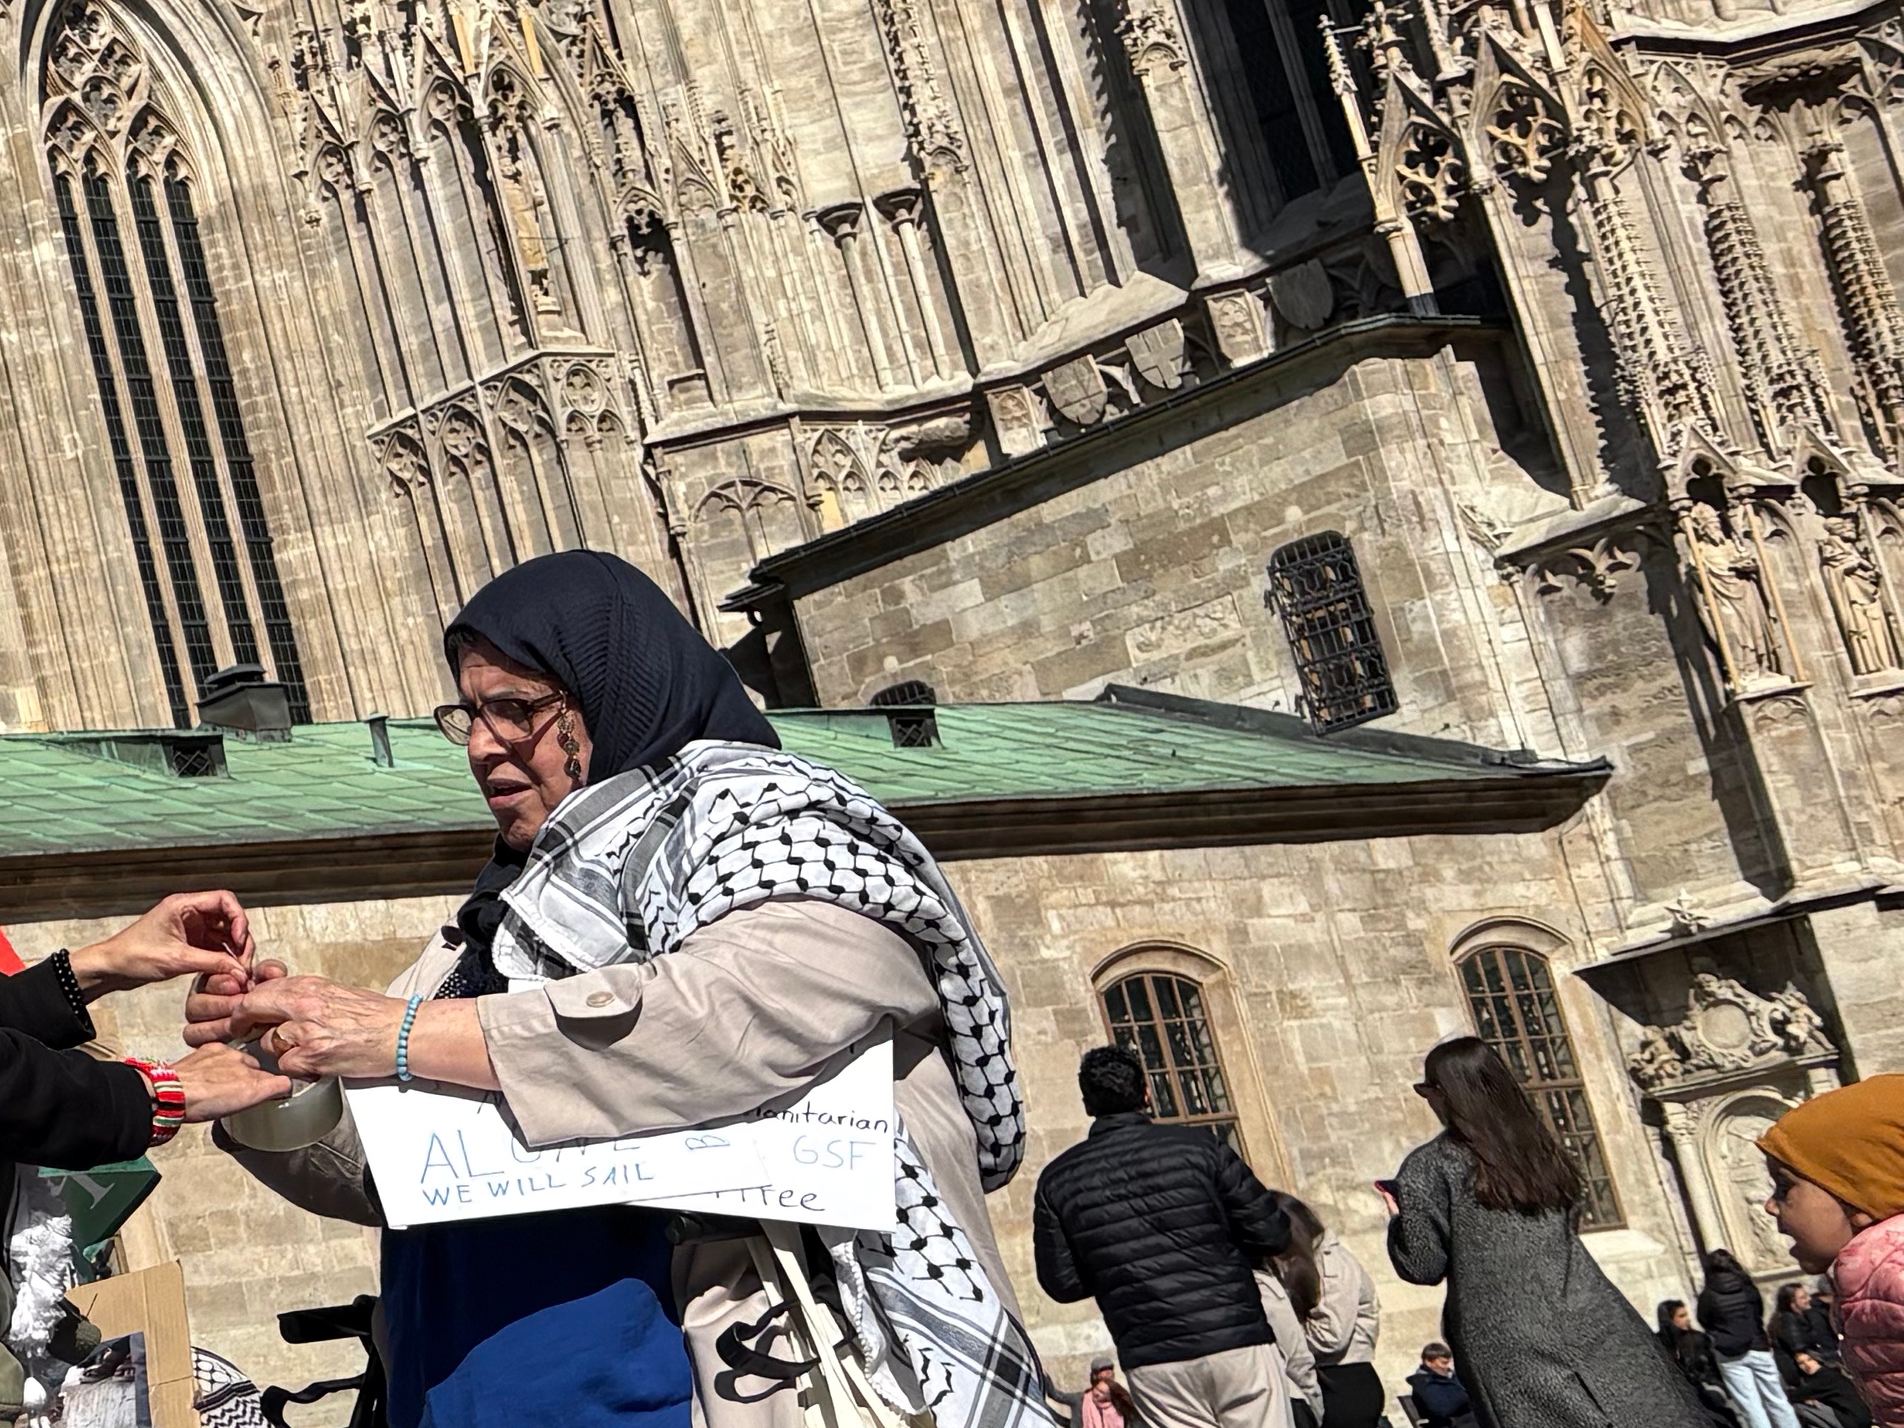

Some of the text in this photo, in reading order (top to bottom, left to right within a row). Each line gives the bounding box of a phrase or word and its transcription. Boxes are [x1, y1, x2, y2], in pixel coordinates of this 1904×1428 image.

[792, 1134, 878, 1170] GSF
[422, 1163, 655, 1206] WE WILL SAIL
